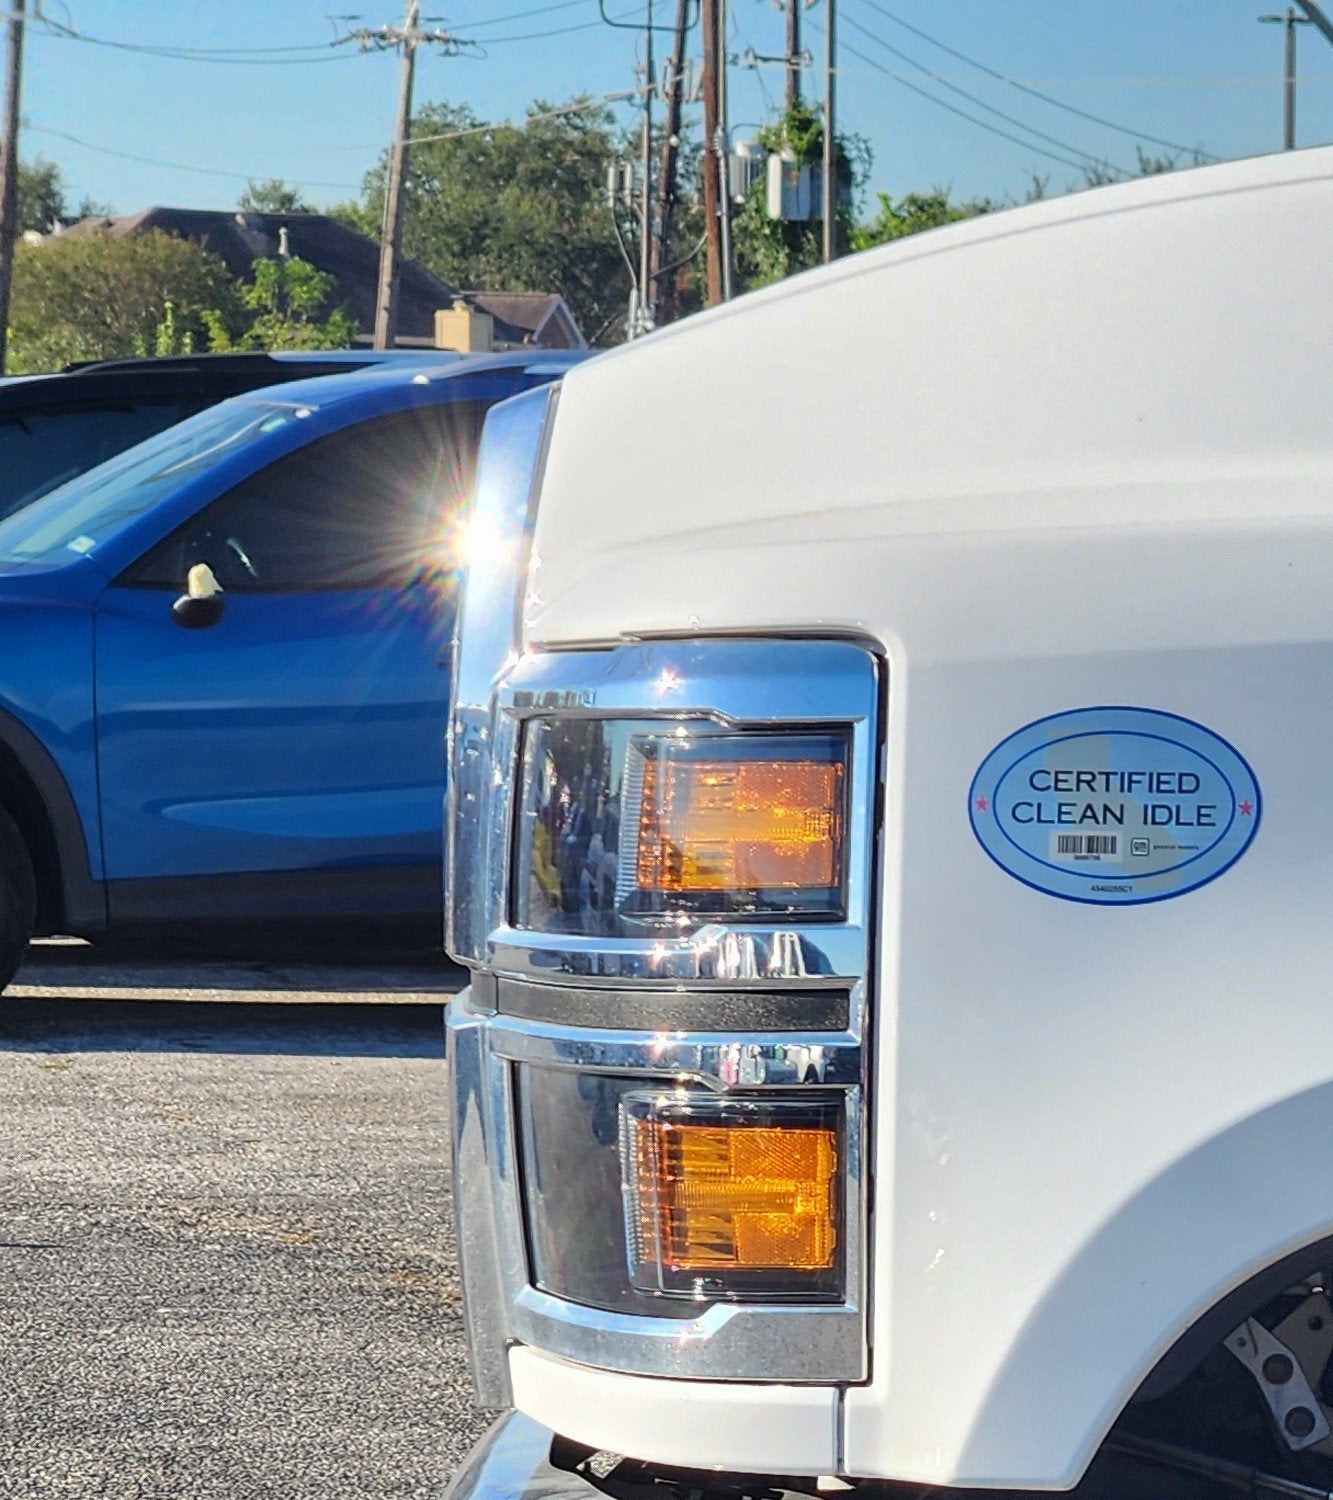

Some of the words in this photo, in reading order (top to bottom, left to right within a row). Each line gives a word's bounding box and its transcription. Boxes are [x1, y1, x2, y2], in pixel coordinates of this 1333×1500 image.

[1028, 769, 1200, 795] CERTIFIED
[1010, 801, 1125, 825] CLEAN
[1142, 804, 1217, 827] IDLE
